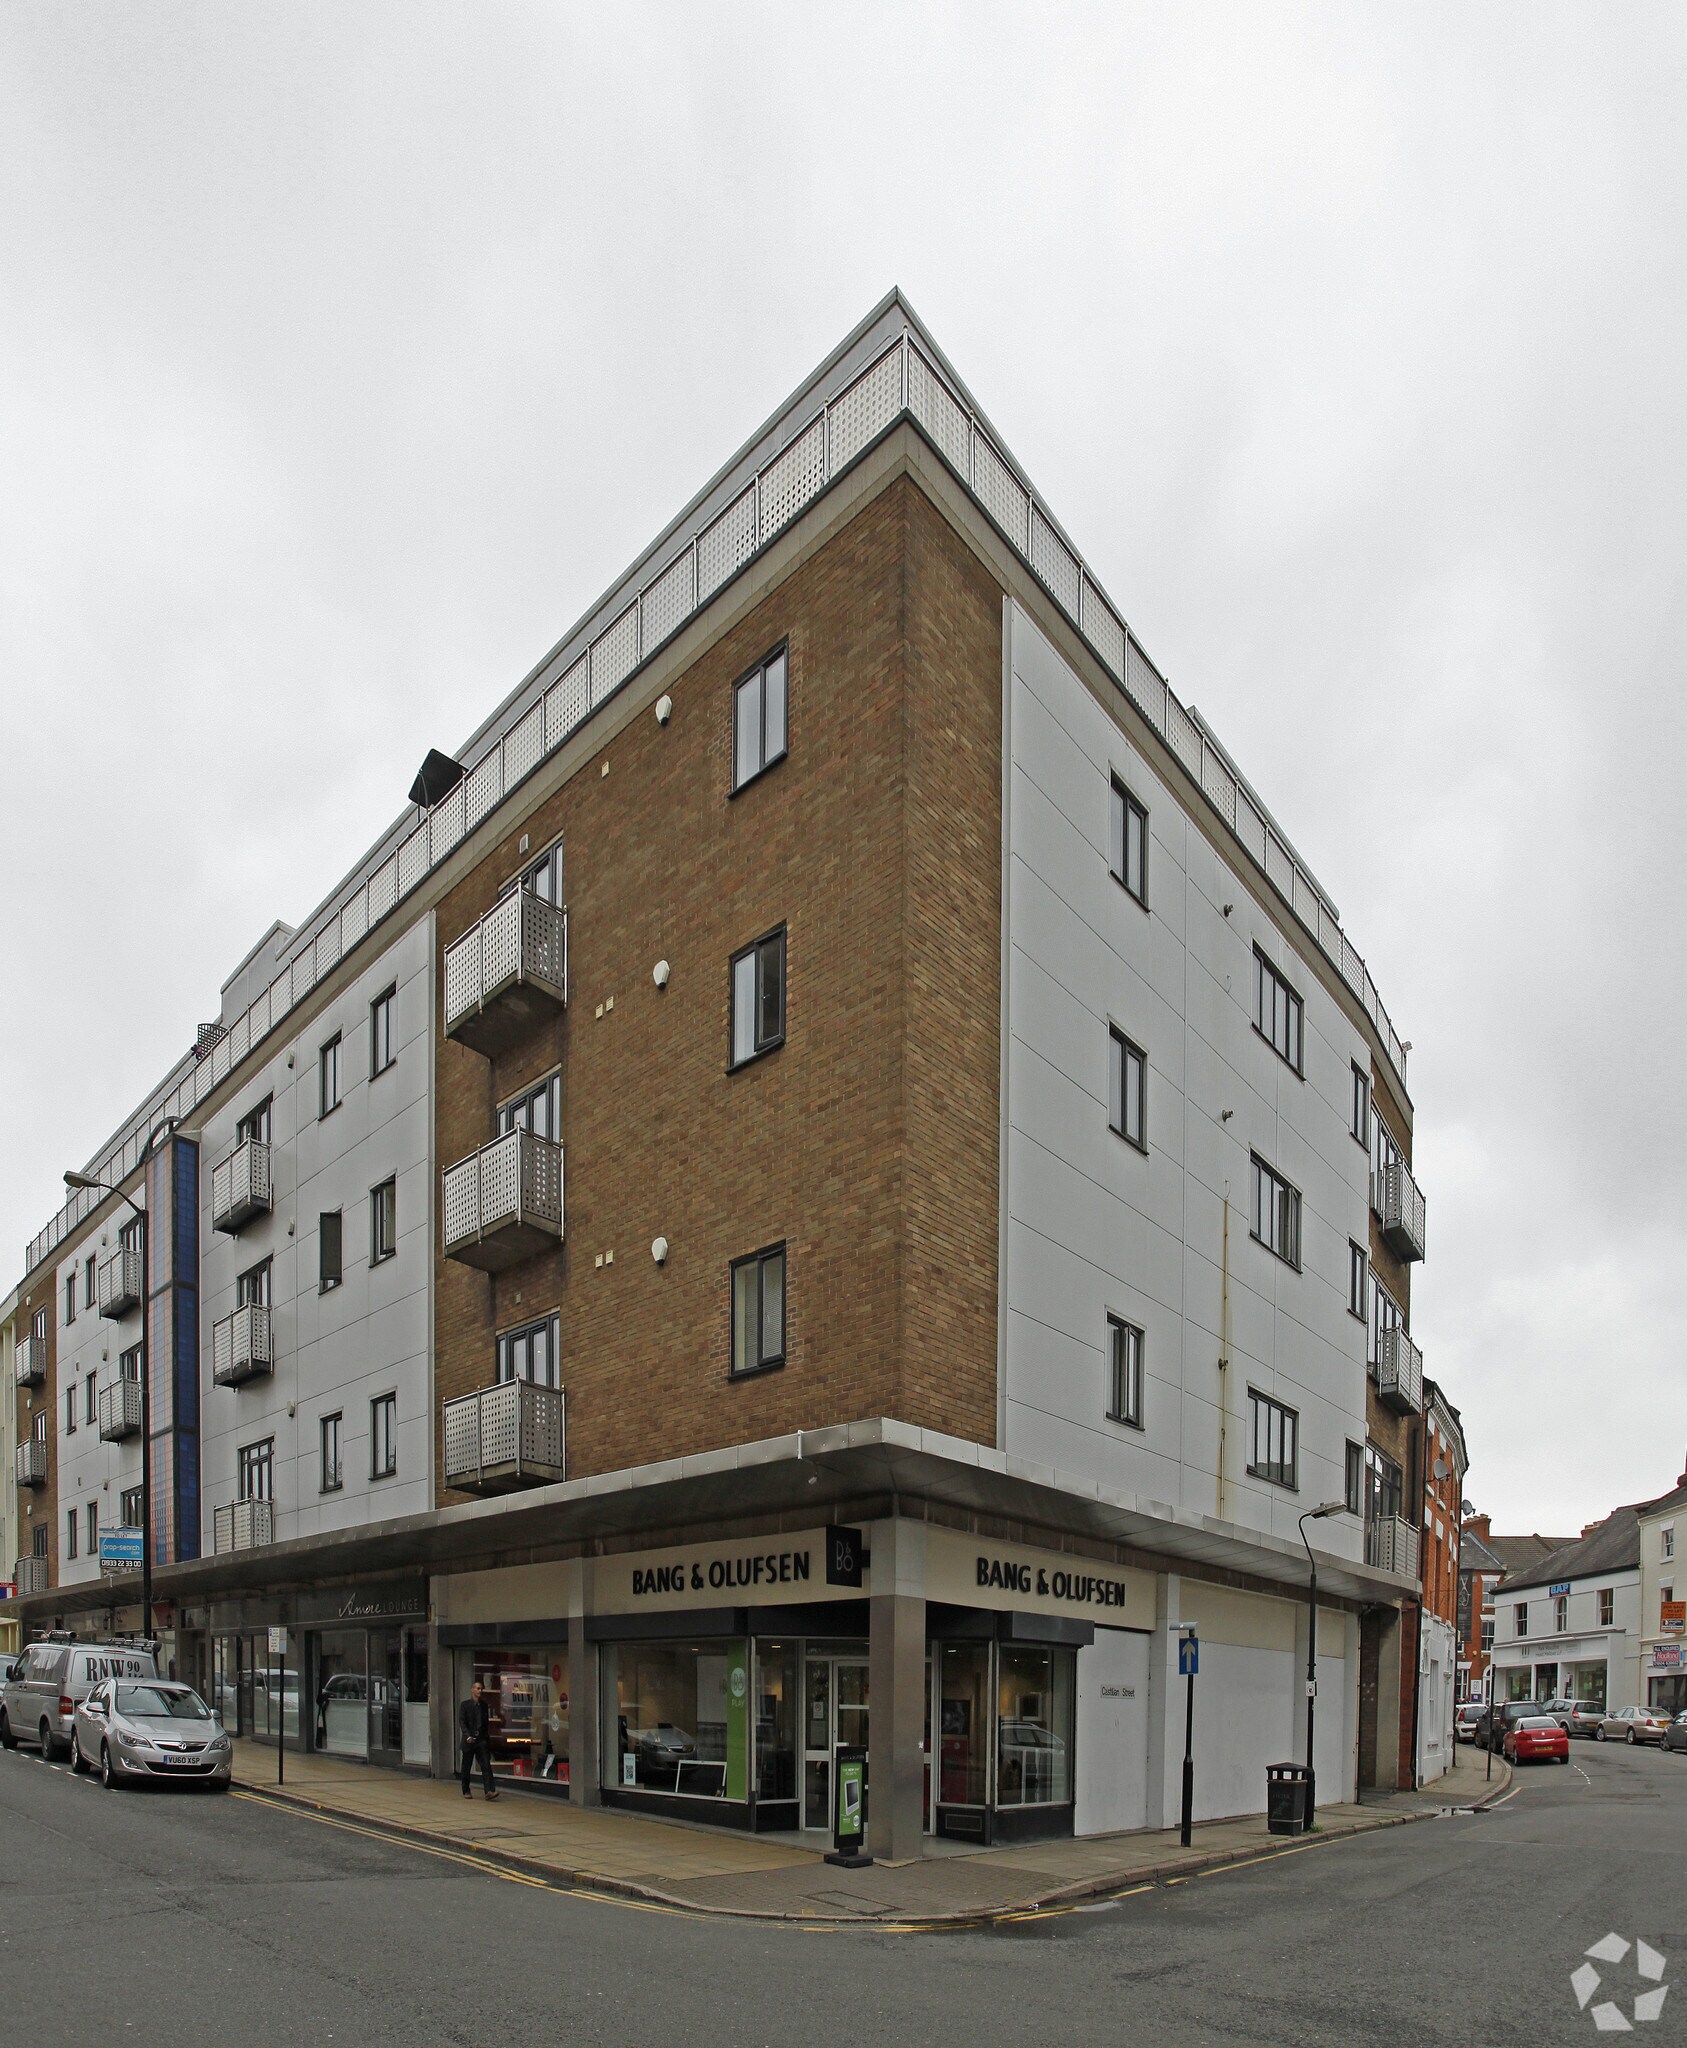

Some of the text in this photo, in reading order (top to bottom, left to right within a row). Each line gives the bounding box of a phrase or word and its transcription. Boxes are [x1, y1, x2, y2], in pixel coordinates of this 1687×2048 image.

[632, 1551, 810, 1595] BANG & OLUFSEN
[976, 1557, 1126, 1608] BANG & OLUFSEN
[1550, 1584, 1569, 1594] GAP
[384, 1598, 418, 1613] LOUNGE
[85, 1657, 140, 1681] RNW 90
[1122, 1687, 1135, 1697] Street
[168, 1755, 201, 1765] VU60 XSP
